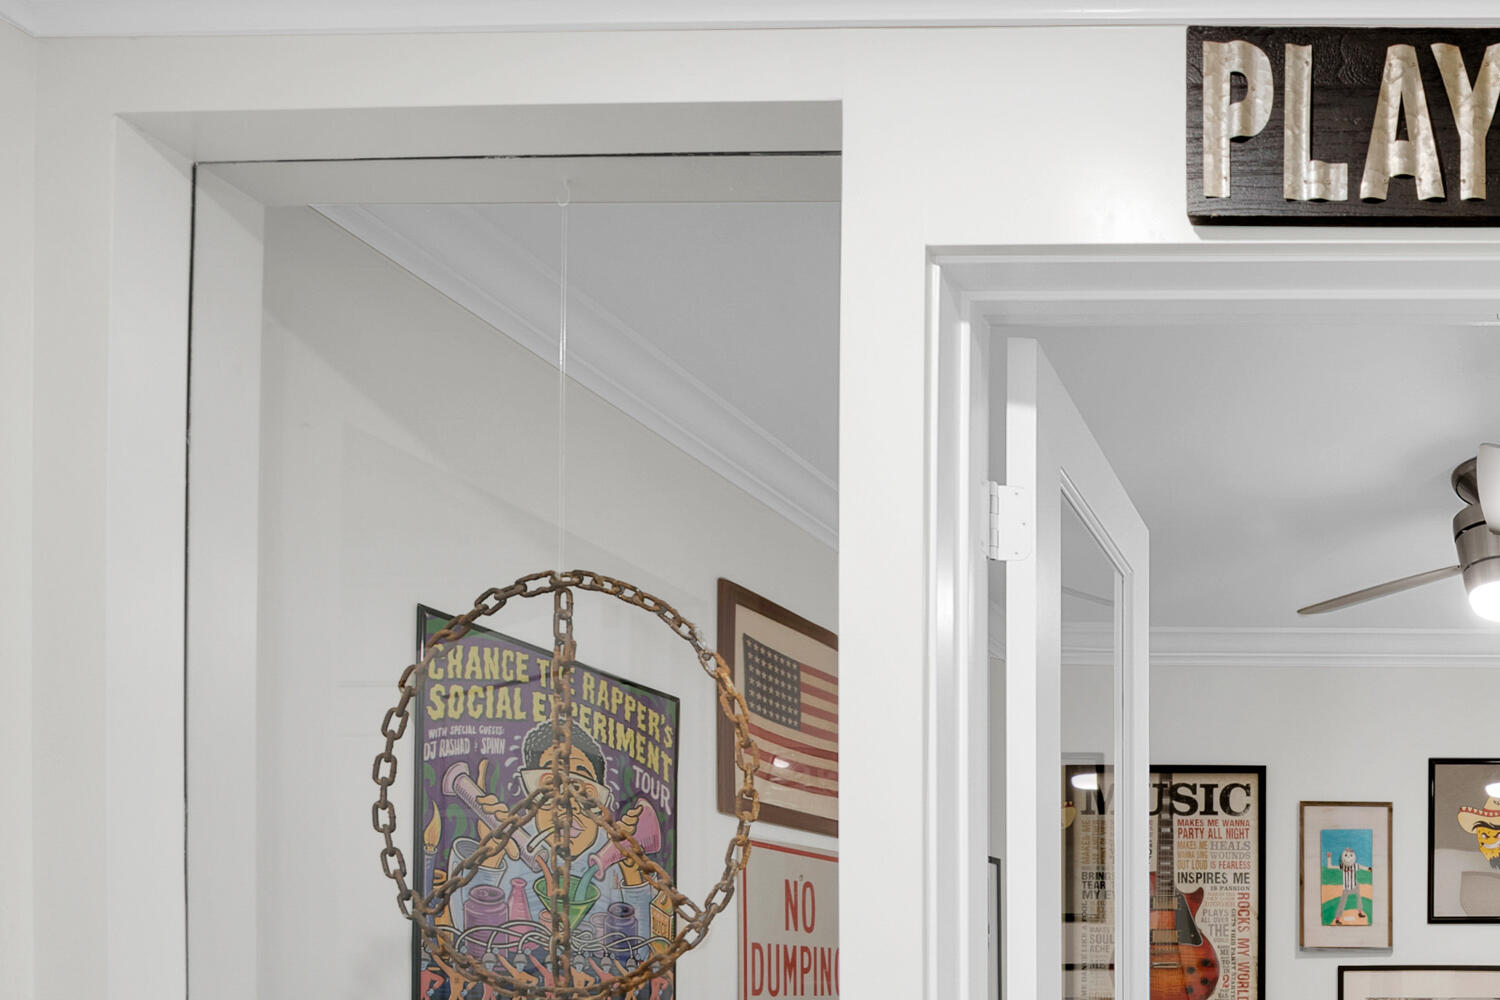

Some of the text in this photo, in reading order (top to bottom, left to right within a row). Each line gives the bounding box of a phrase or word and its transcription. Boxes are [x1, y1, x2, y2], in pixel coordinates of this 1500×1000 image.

[426, 683, 526, 721] SOCIAL
[427, 643, 530, 684] CHANCE
[582, 671, 673, 749] RAPPER'S
[428, 727, 448, 739] WITH
[449, 725, 478, 735] SPECIAL
[423, 741, 437, 761] DJ
[439, 737, 471, 758] RASHAD
[632, 764, 672, 817] TOUR
[1177, 819, 1250, 827] MAKES ME WANNA
[1177, 828, 1250, 839] PARTY ALL NIGHT
[1210, 841, 1251, 850] HEALS
[1210, 852, 1251, 860] WOUNDS
[1218, 861, 1251, 869] FEARLESS
[1177, 872, 1250, 884] INSPIRES ME
[784, 878, 816, 934] NO
[1202, 909, 1229, 917] PLAYS
[1237, 892, 1250, 933] ROCKS
[1208, 924, 1229, 937] THE
[1237, 938, 1250, 957] MY
[751, 942, 839, 998] DUMPIN
